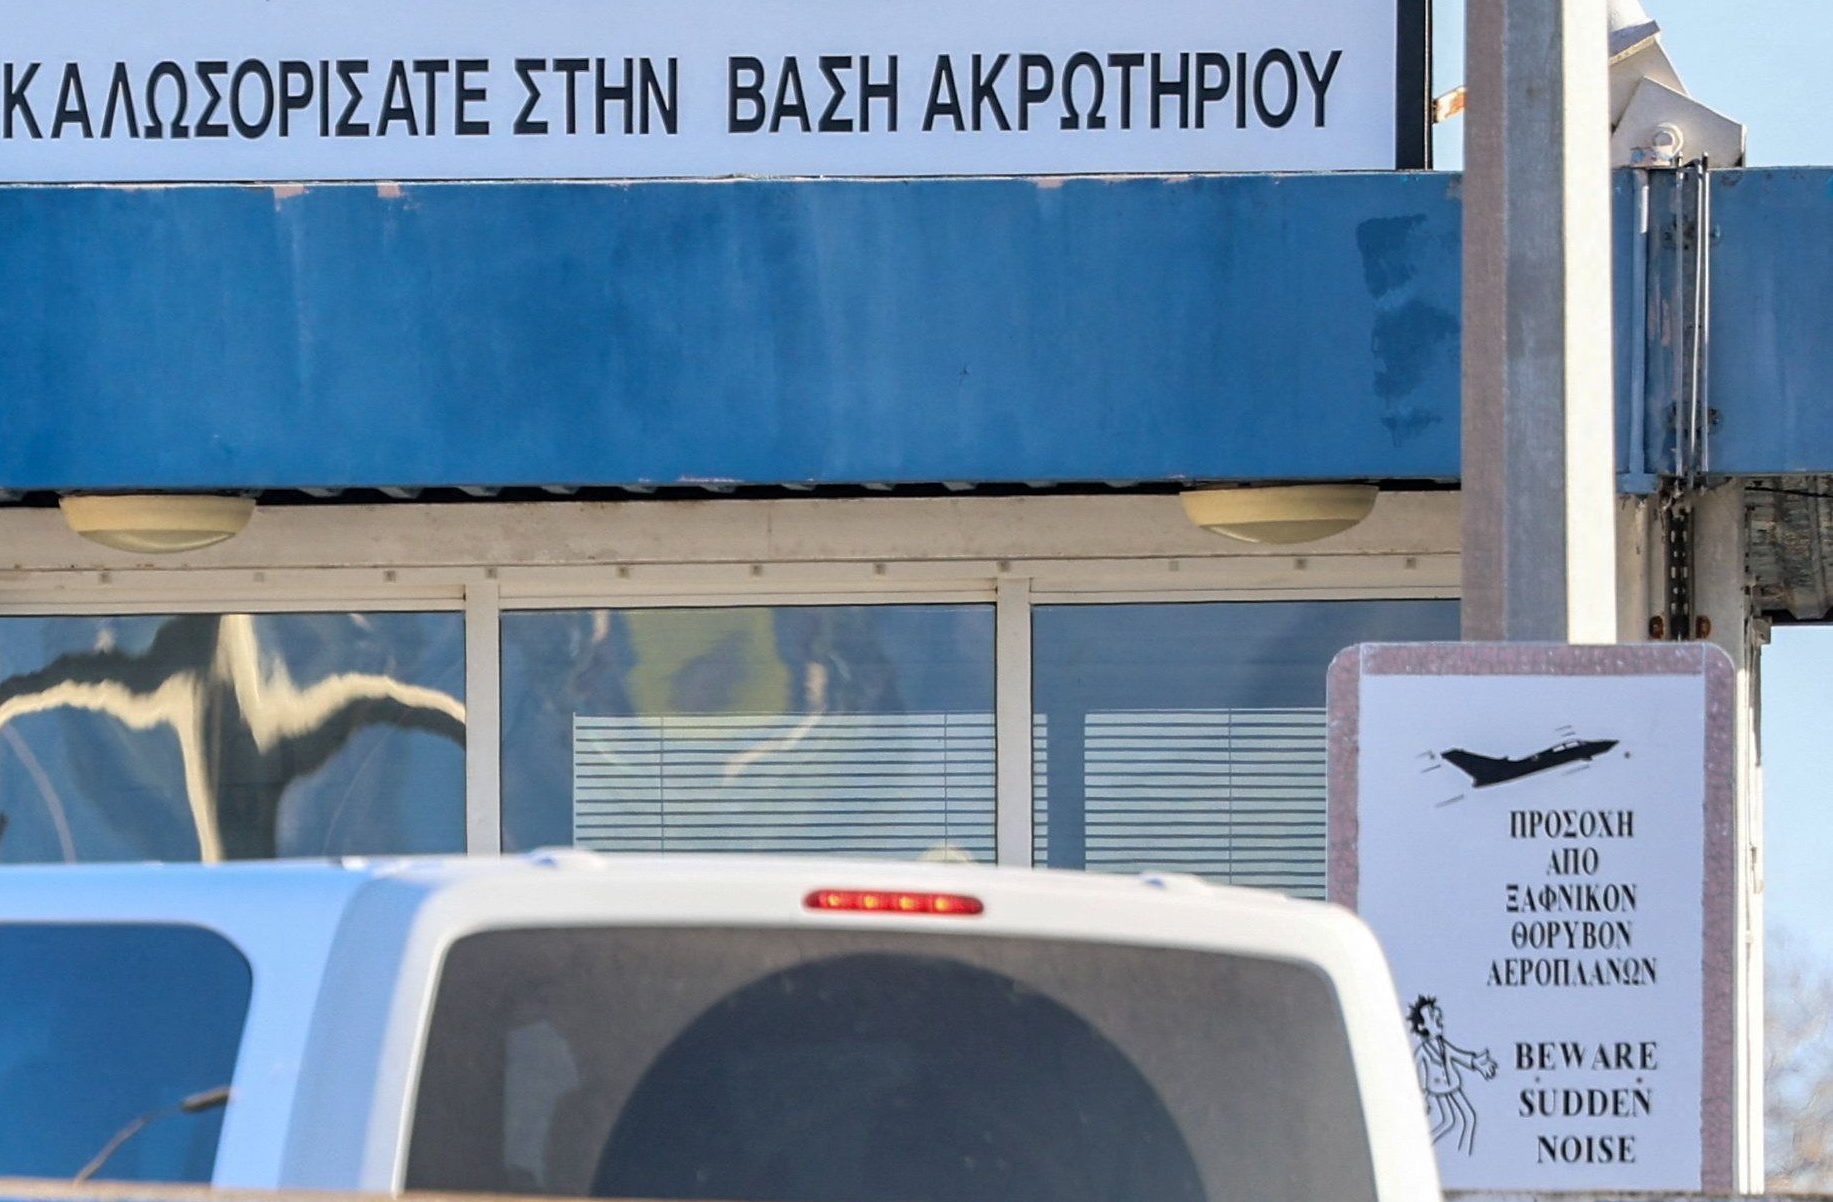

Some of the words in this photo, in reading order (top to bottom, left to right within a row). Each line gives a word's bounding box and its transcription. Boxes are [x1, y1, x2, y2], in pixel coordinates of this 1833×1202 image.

[2, 58, 491, 140] ΚΑΛΩΣΟΡΙΣΑΤΕ
[513, 57, 679, 136] ΣΤΗΝ
[728, 54, 898, 134] ΒΑΣΗ
[921, 47, 1343, 133] ΑΚΡΩΤΗΡΙΟΥ
[1509, 809, 1635, 839] ΠΡΟΣΟΧΗ
[1546, 847, 1600, 876] ΑΠΟ
[1505, 883, 1637, 913] ΞΑΦΝΙΚΟΝ
[1511, 920, 1633, 950] ΘΟΡΥΒΟΝ
[1486, 957, 1658, 987] ΑΕΡΟΠΛΑΝΩΝ
[1514, 1041, 1659, 1071] BEWARE
[1519, 1088, 1653, 1118] SUDDEN
[1536, 1135, 1637, 1165] NOISE
